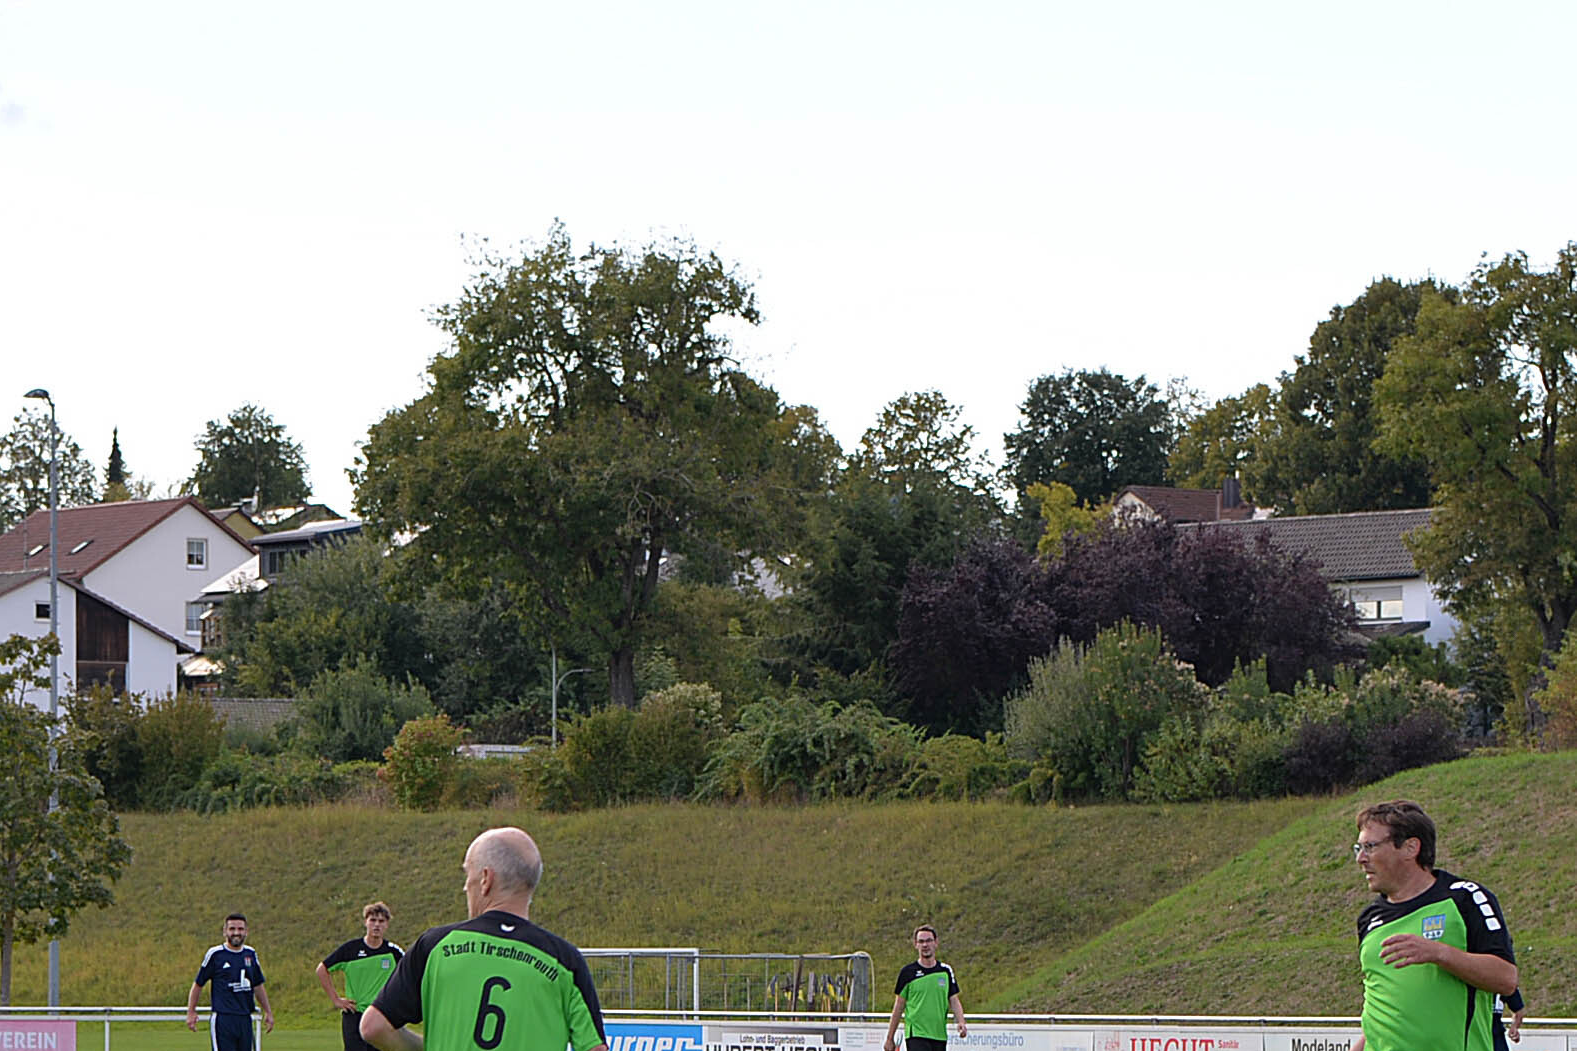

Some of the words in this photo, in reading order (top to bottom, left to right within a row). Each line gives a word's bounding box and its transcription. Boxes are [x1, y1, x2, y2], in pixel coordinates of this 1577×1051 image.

[443, 941, 476, 958] Stadt
[480, 941, 559, 982] Tirschenreuth
[473, 976, 512, 1051] 6
[947, 1032, 1024, 1048] ersicherungsbüro
